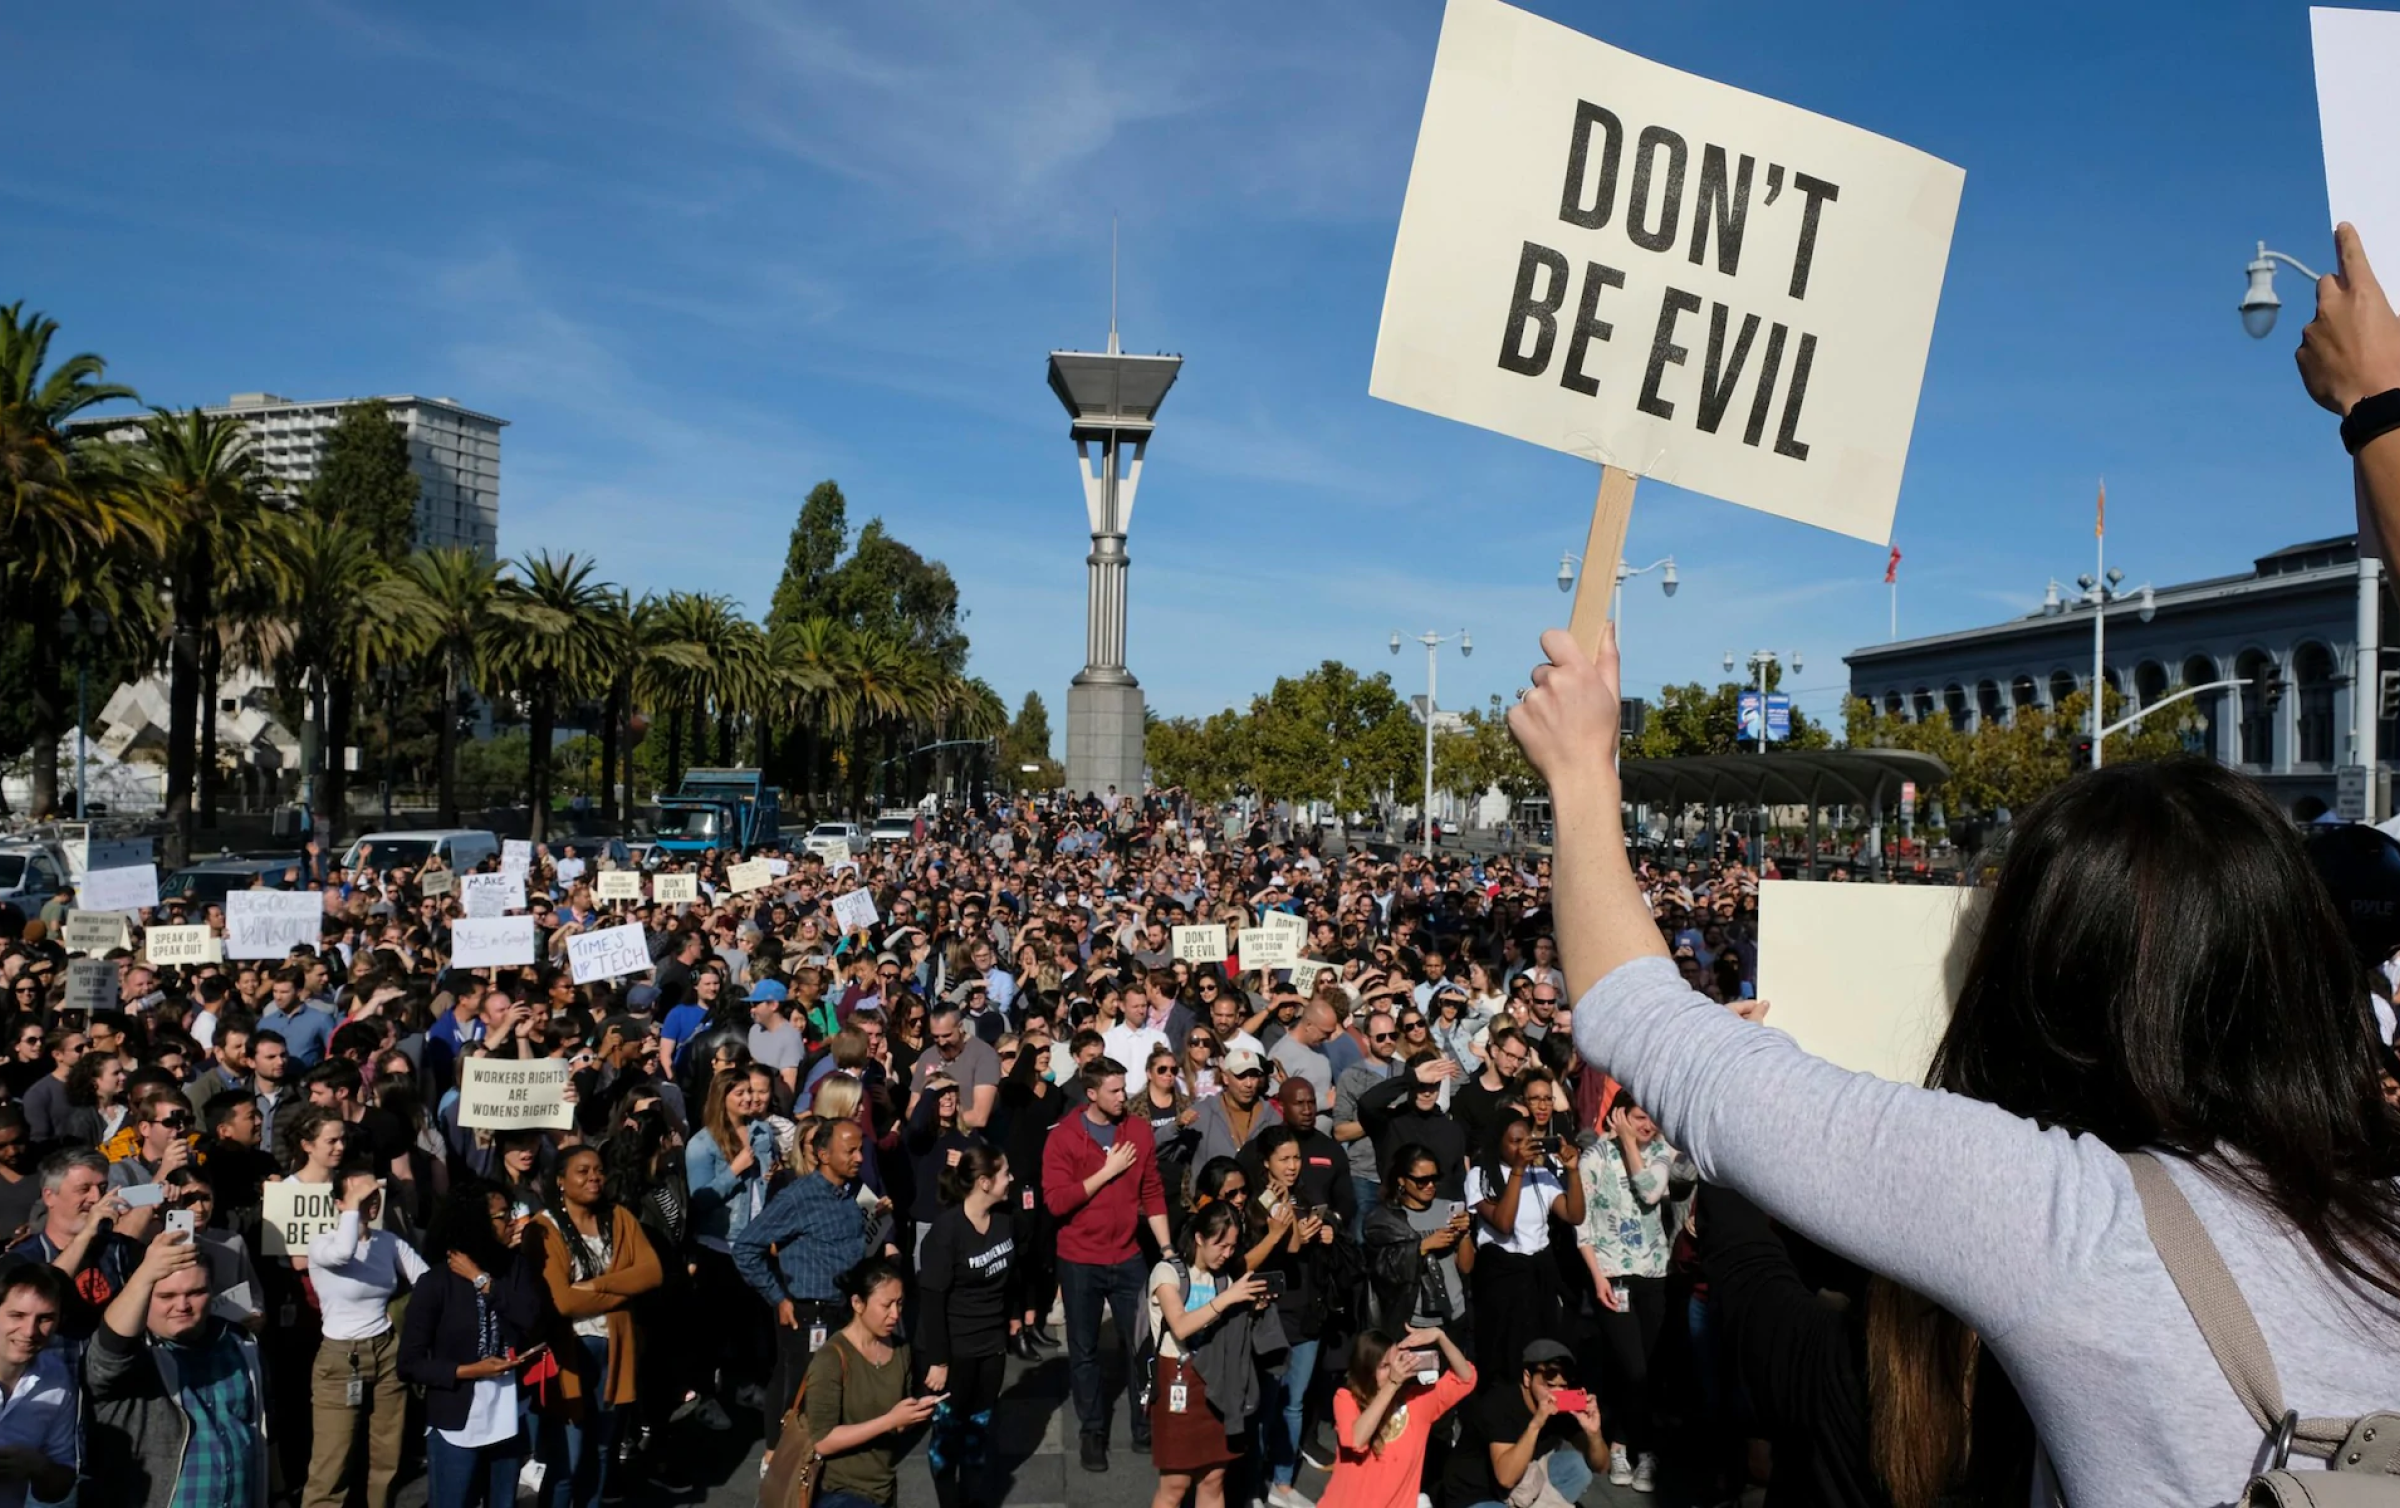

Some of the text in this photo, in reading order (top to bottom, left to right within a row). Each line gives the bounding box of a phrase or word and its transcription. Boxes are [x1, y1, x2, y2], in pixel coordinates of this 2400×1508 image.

[1557, 98, 1840, 301] DON'T
[1497, 240, 1819, 463] BE EVIL
[467, 875, 506, 890] MAKE
[663, 878, 686, 888] DON'T
[661, 889, 688, 899] BE EVIL
[154, 931, 184, 944] SPEAK
[572, 931, 625, 956] TIME'S
[1184, 931, 1213, 943] DON'T
[152, 944, 203, 957] SPEAK OUT
[1182, 944, 1216, 958] BE EVIL
[573, 946, 647, 980] UP TECH
[1300, 966, 1316, 979] SPE
[473, 1070, 565, 1084] WORKERS RIGHTS
[508, 1089, 529, 1101] ARE
[472, 1103, 560, 1117] WOMENS RIGHTS
[294, 1195, 335, 1218] DON
[286, 1222, 310, 1245] BE
